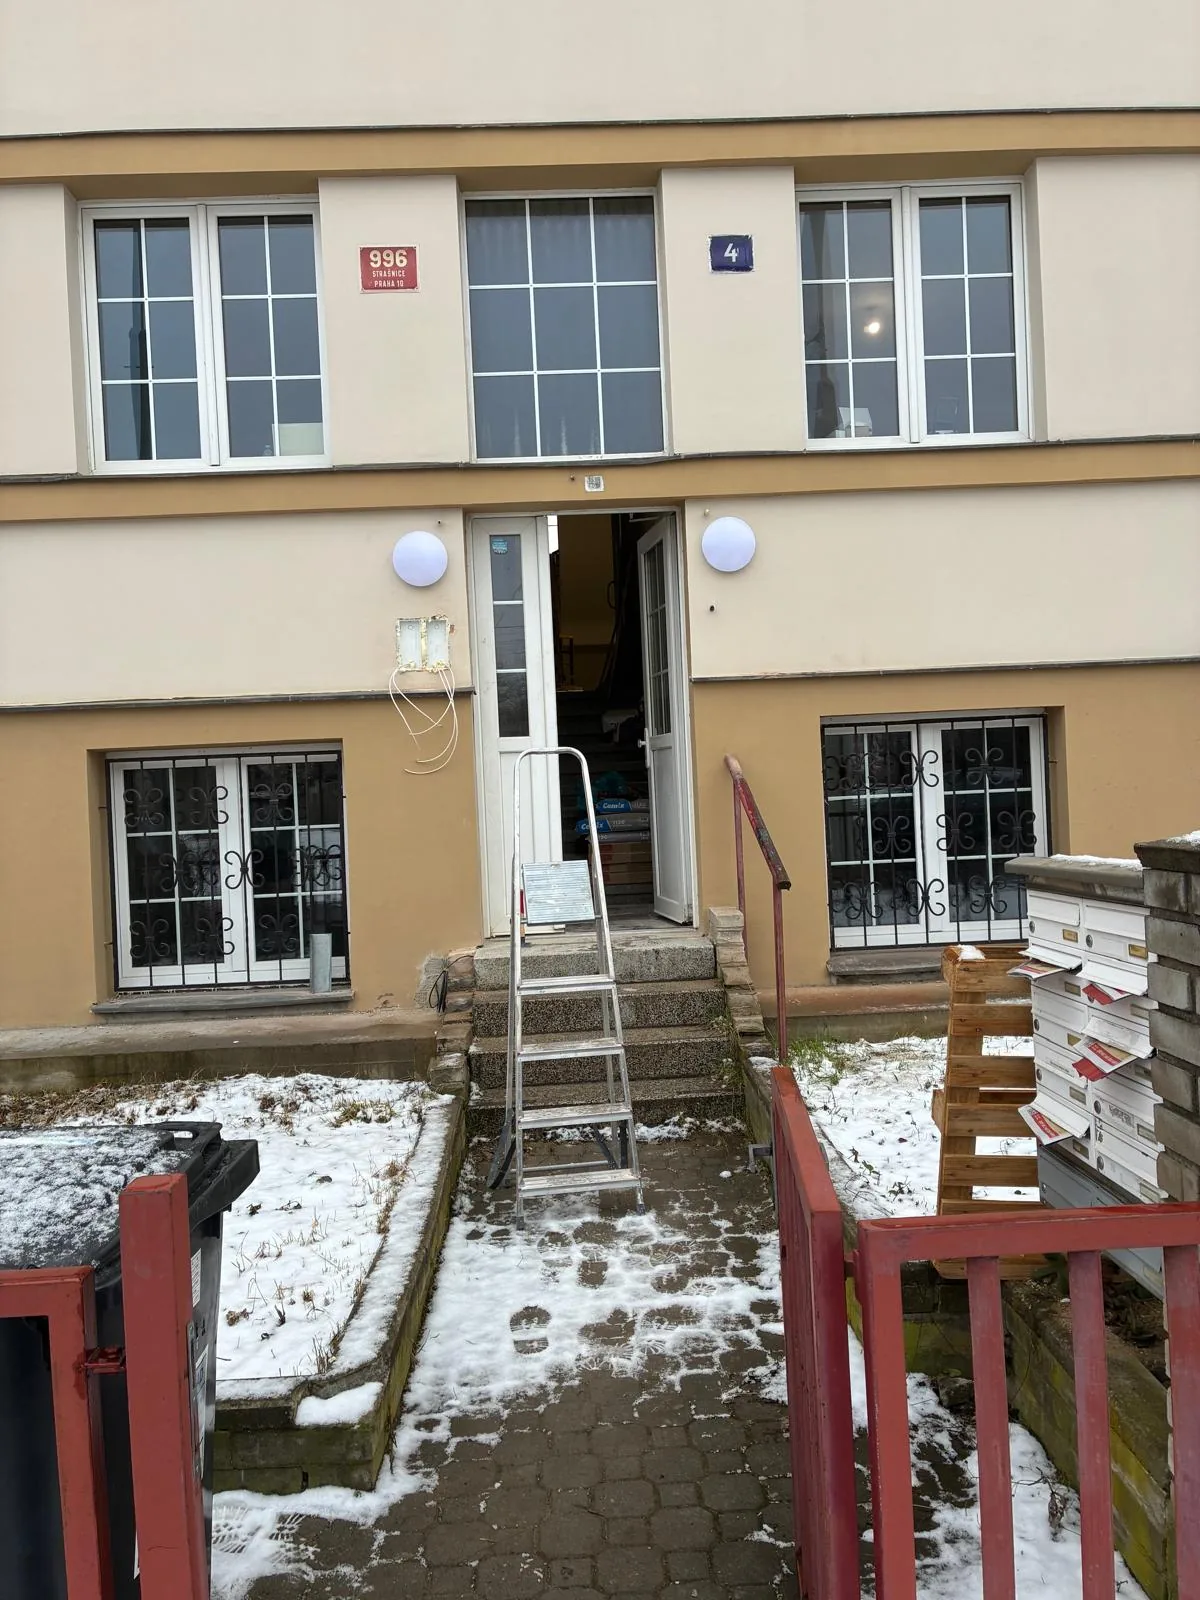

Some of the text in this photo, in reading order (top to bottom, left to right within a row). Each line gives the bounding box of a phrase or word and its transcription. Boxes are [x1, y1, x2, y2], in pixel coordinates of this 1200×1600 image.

[369, 249, 408, 268] 996
[724, 242, 738, 263] 4
[372, 268, 406, 278] STRAŠNICE
[374, 279, 404, 288] PRAHA 10
